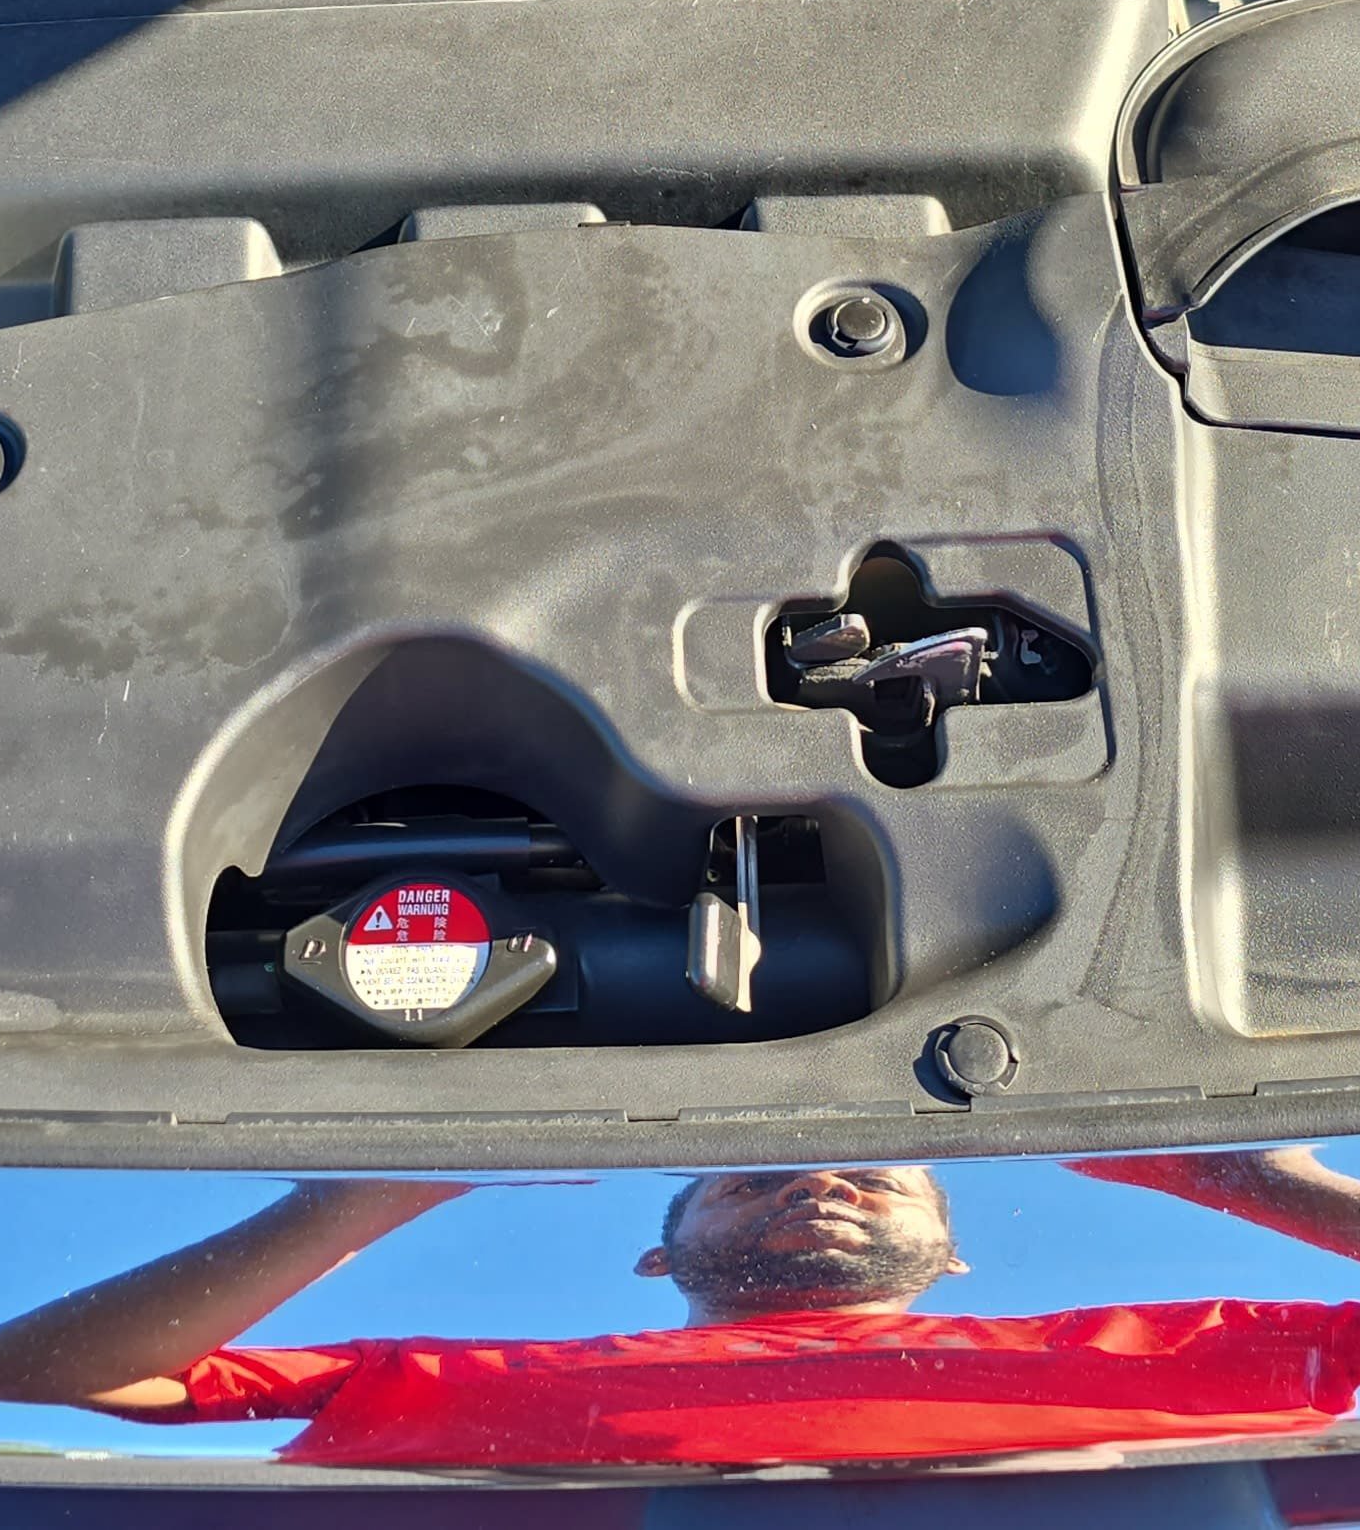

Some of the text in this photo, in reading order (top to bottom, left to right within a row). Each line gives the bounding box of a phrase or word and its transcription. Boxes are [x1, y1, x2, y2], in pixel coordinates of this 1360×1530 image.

[398, 890, 451, 903] DANGER
[397, 904, 449, 916] WARNUNG
[404, 1008, 424, 1023] 1.1
